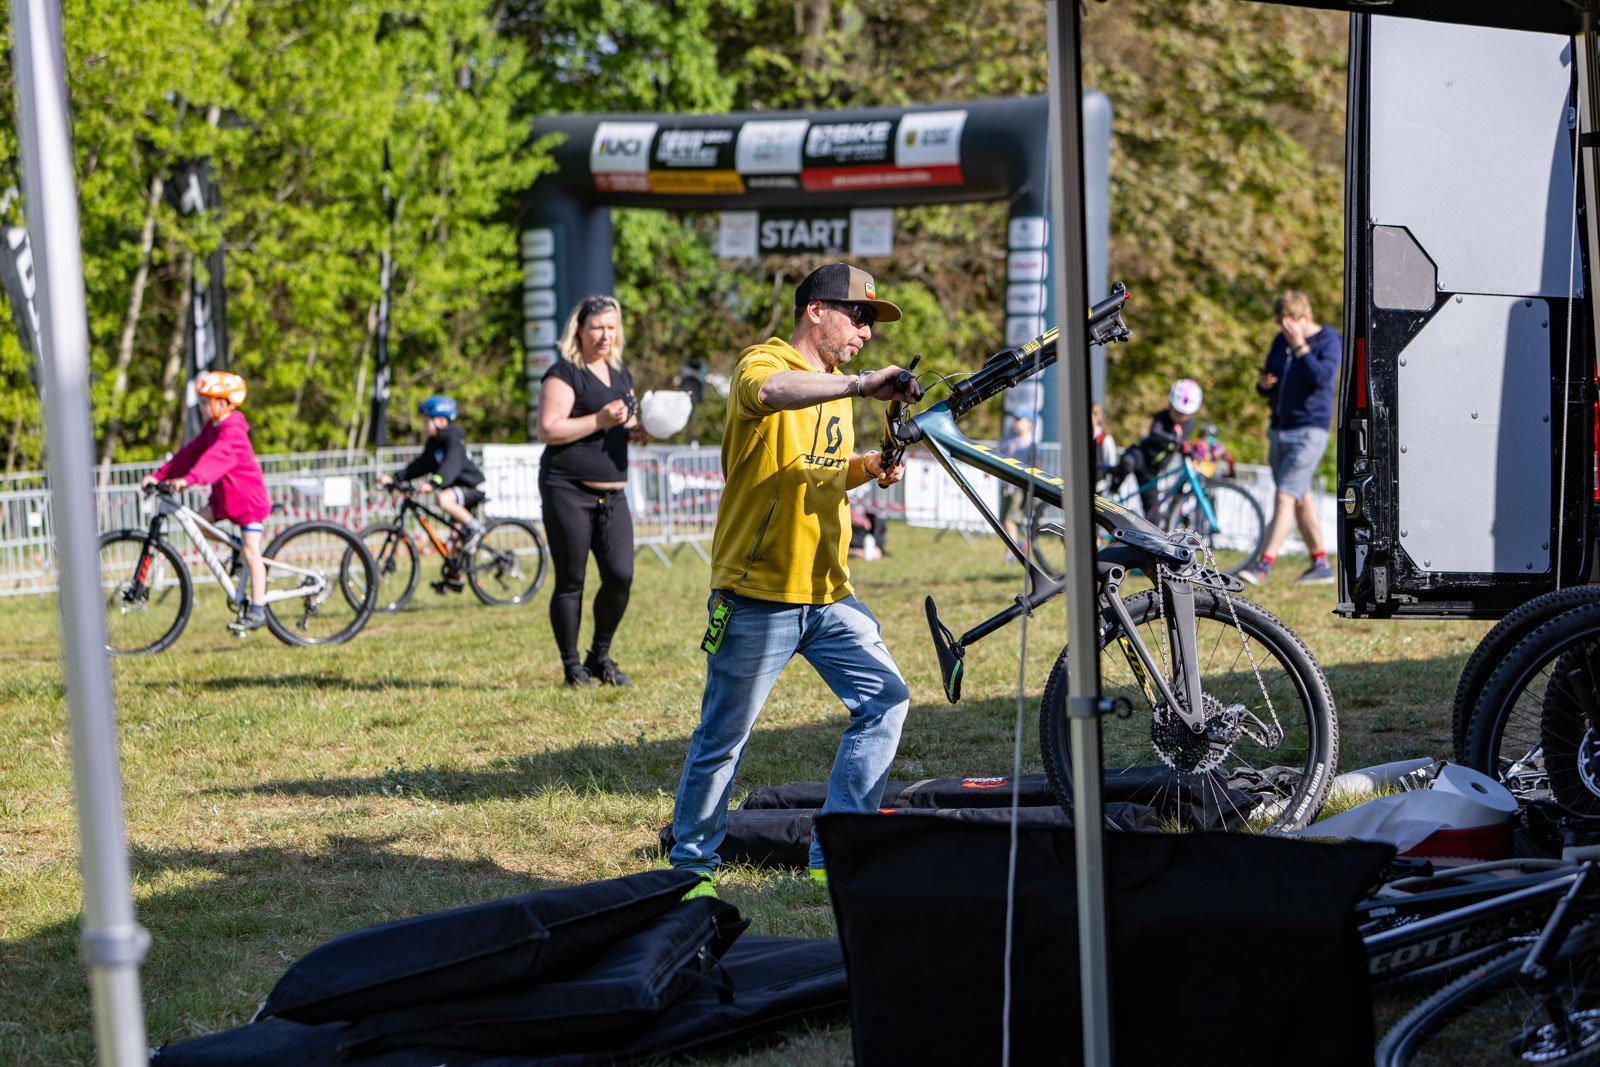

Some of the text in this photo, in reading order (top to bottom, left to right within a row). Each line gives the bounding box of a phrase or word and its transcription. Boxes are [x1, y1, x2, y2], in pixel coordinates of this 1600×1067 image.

[760, 218, 847, 249] START
[804, 454, 847, 468] SCOT
[960, 440, 1065, 490] OTT
[1367, 926, 1471, 975] COTT
